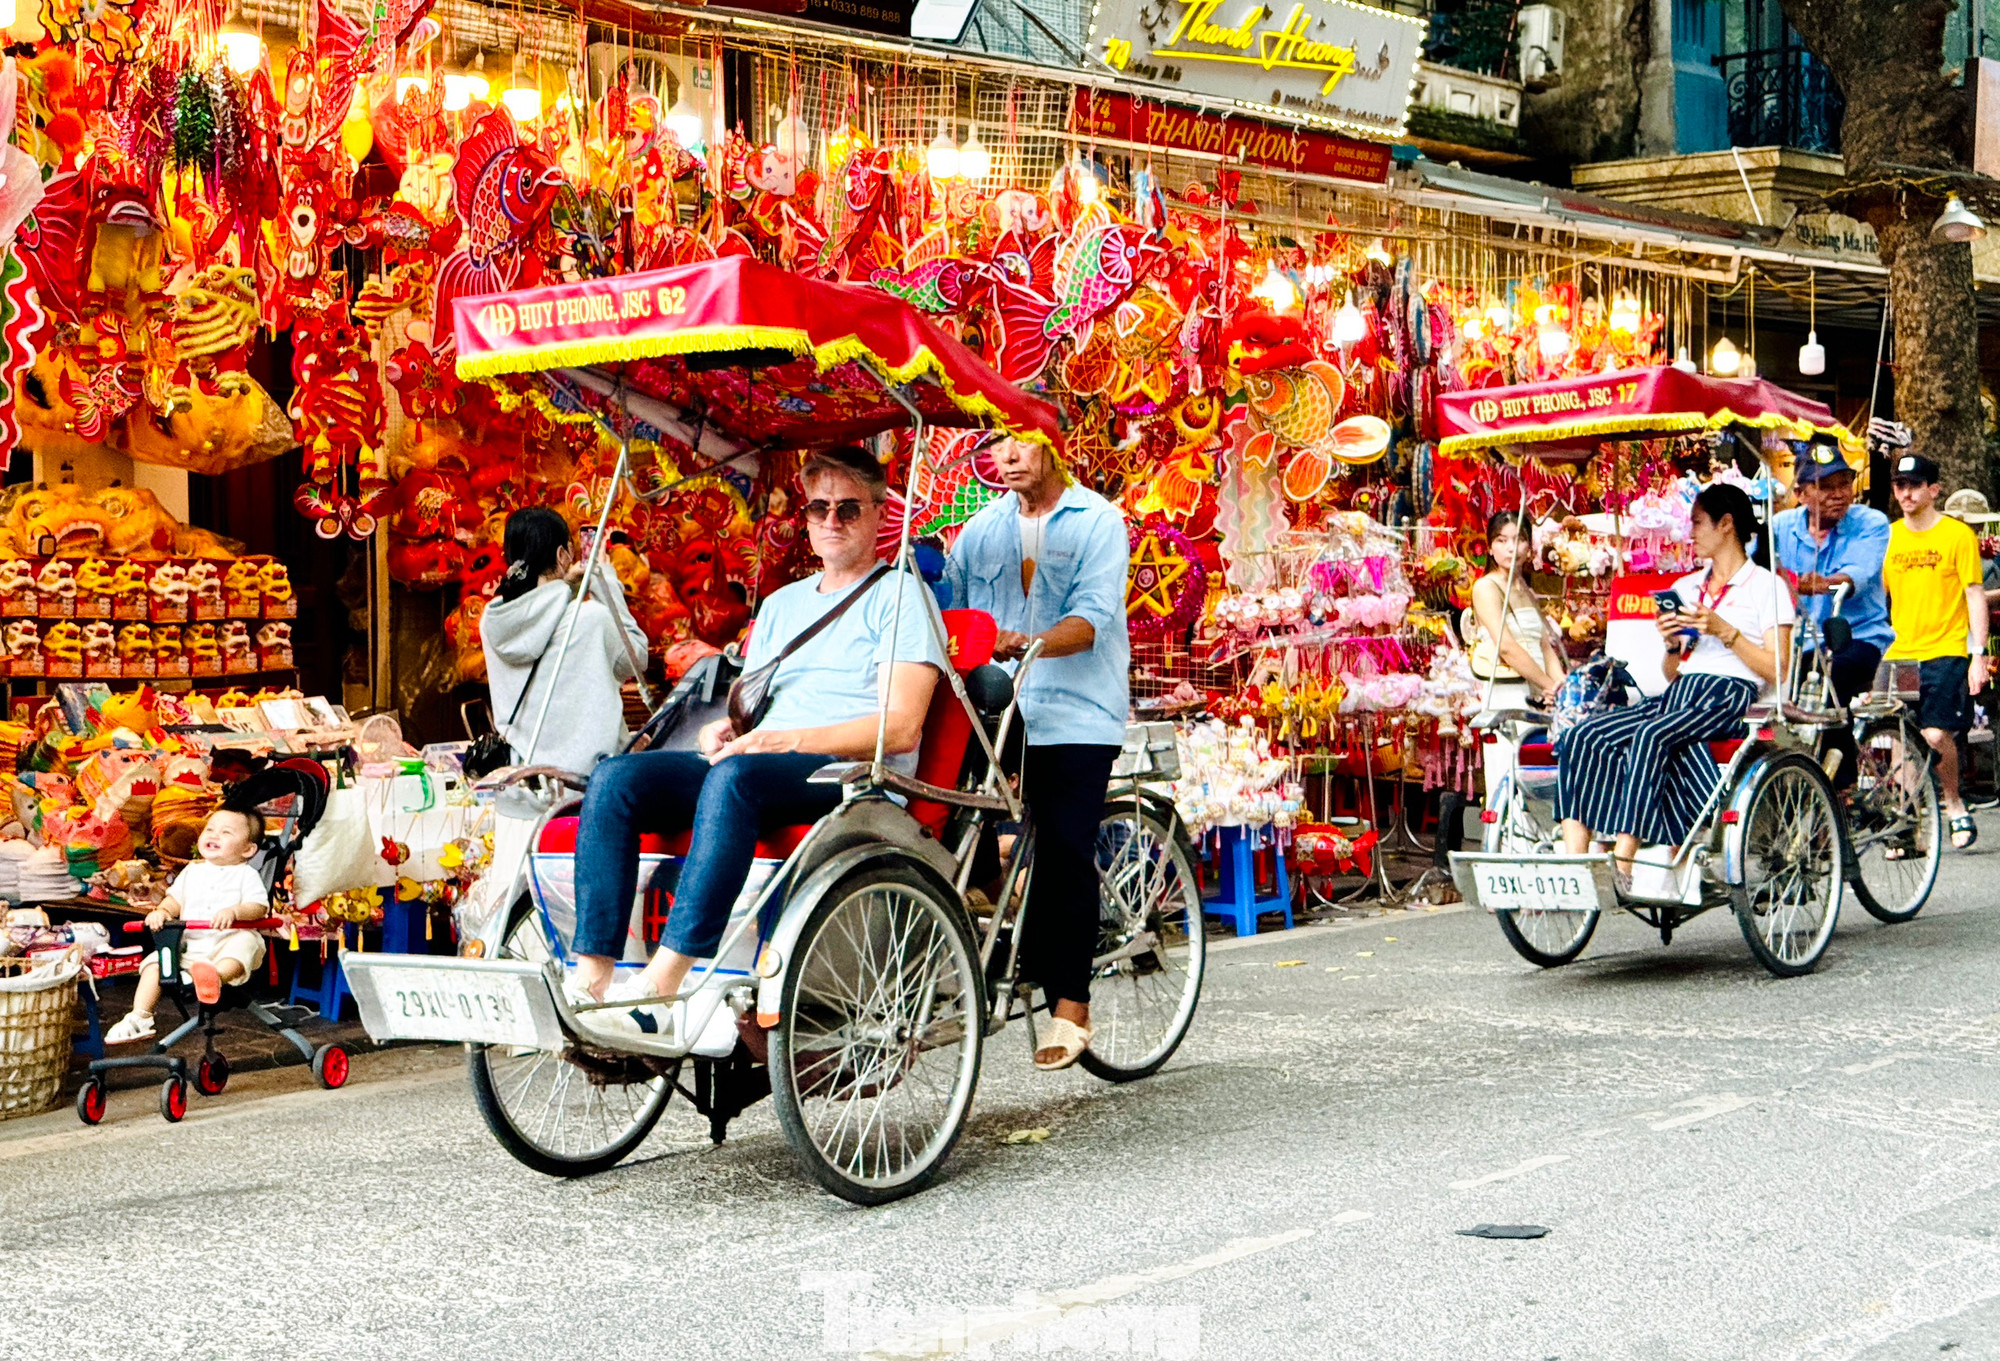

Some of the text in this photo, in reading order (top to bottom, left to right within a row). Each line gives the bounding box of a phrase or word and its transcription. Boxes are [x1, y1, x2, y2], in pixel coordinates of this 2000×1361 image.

[831, 0, 857, 15] 0333
[1169, 0, 1263, 50] Thanh
[1149, 110, 1227, 151] THANH
[517, 301, 554, 332] HUY
[620, 289, 651, 319] JSC
[657, 285, 686, 315] 62
[1502, 398, 1532, 419] HUY
[1588, 386, 1613, 408] JSC
[1616, 382, 1638, 404] 17
[1487, 875, 1581, 896] 29XL-0123
